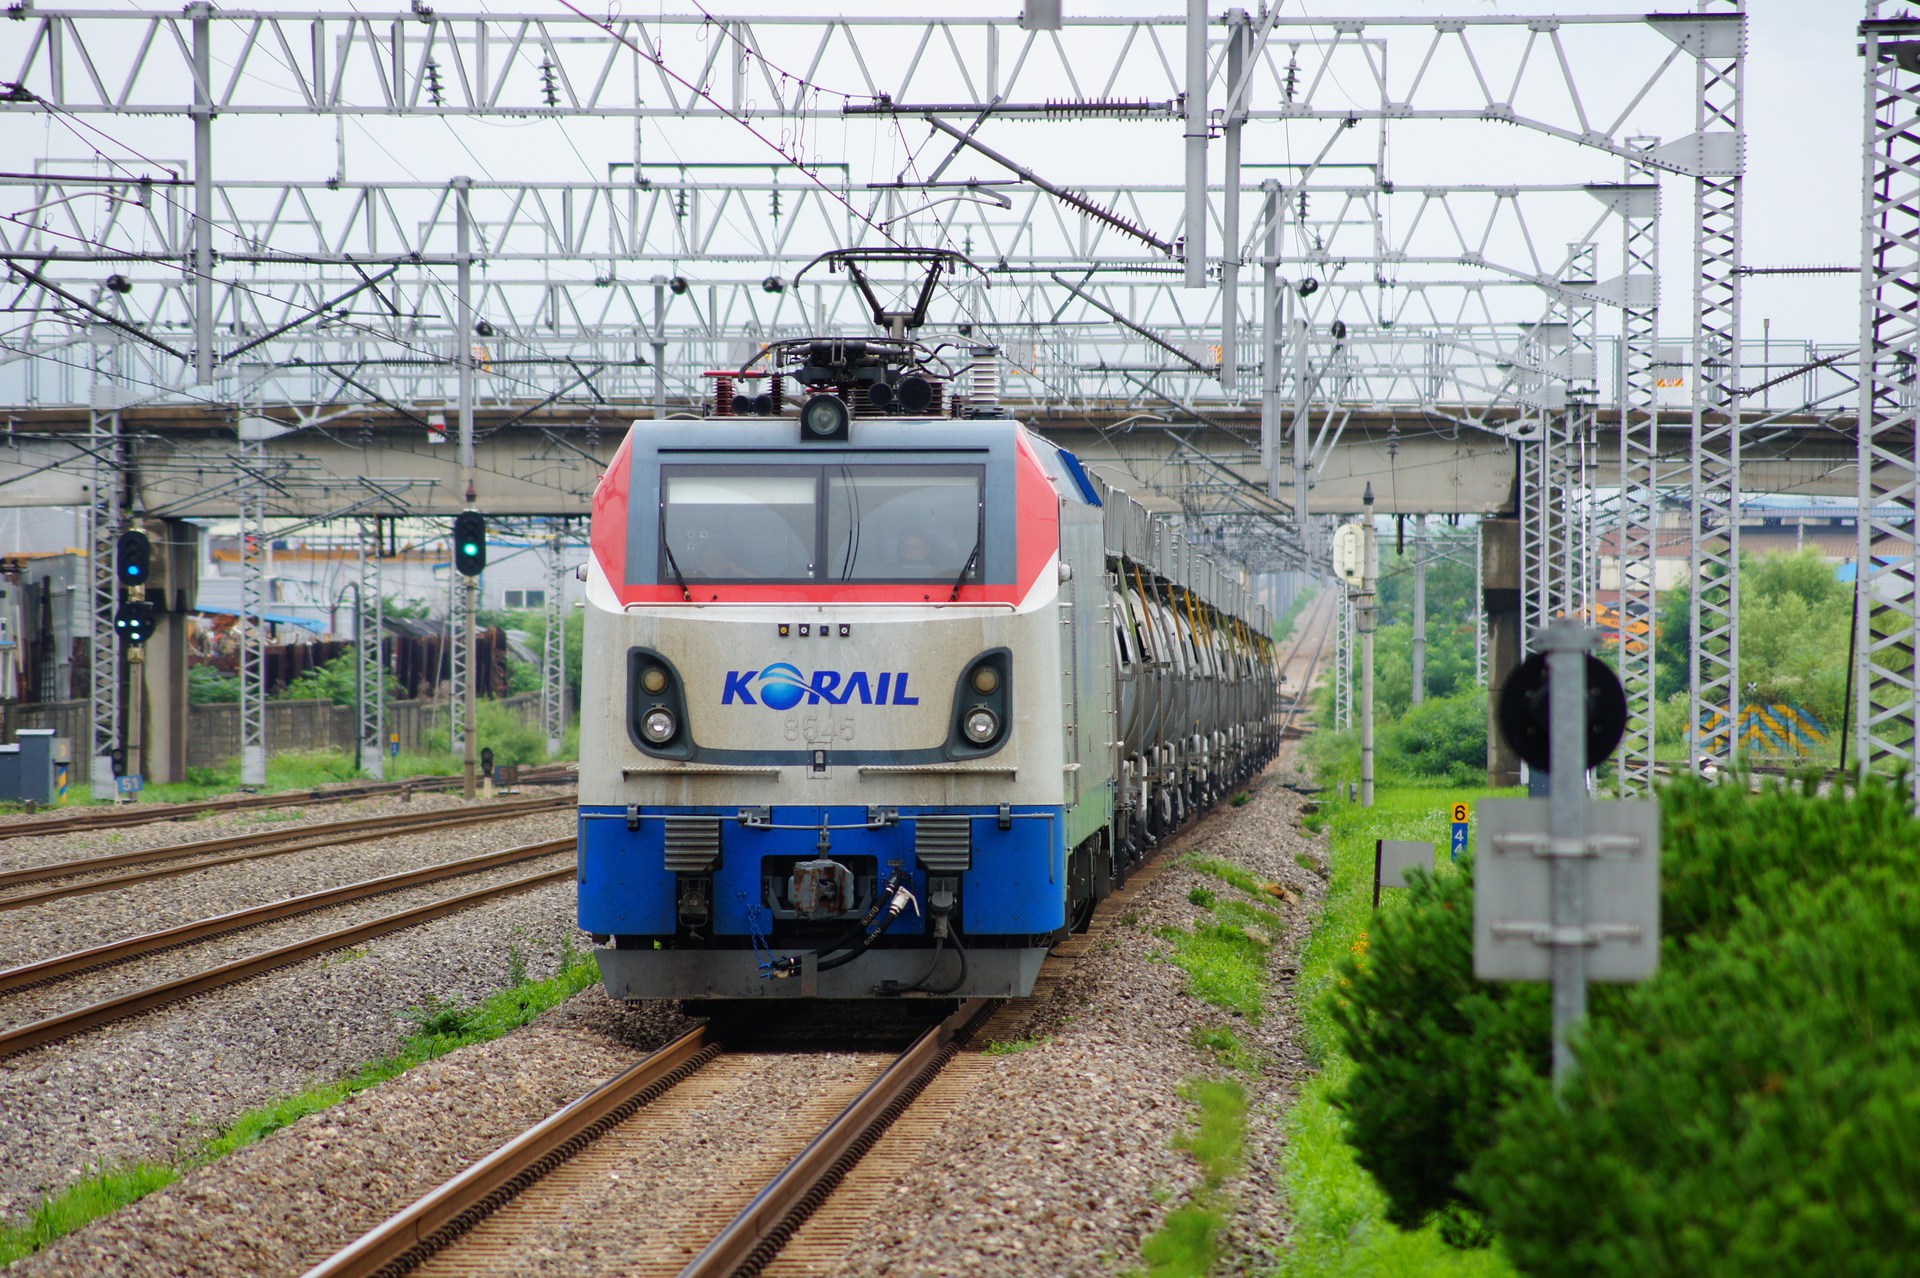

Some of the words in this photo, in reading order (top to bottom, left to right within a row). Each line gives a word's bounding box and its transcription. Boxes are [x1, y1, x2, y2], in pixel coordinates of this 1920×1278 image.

[721, 662, 919, 711] KORAIL
[784, 715, 856, 742] 8545
[122, 777, 139, 791] 51
[1455, 805, 1465, 821] 6
